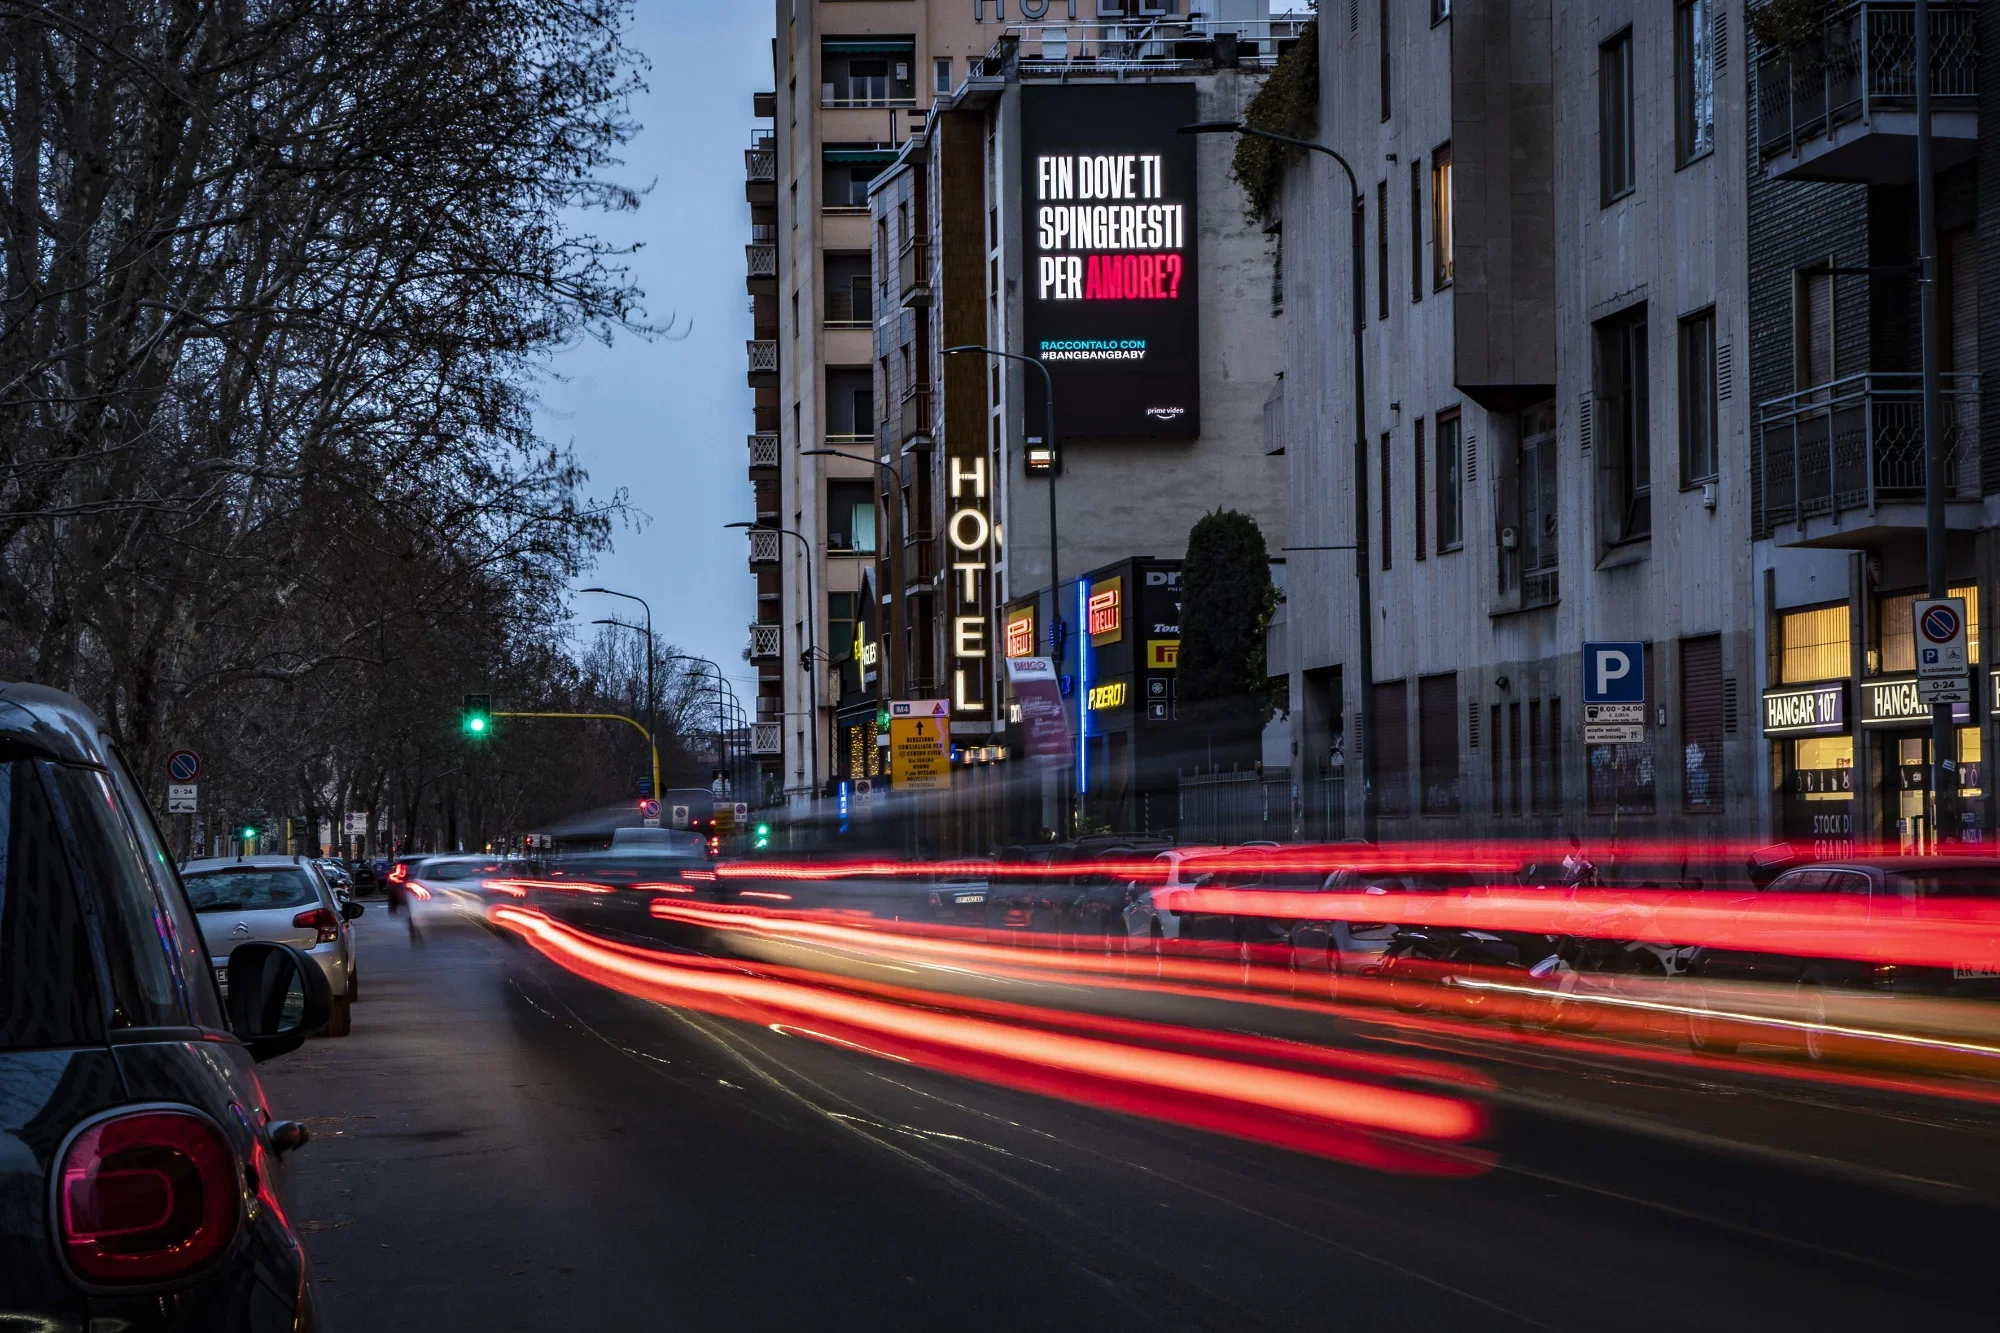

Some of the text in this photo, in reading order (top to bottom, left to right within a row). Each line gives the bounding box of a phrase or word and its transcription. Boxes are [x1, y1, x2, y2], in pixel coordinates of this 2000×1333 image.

[1039, 155, 1161, 200] FIN DOVE TI
[1039, 204, 1183, 249] SPINGERESTI
[1039, 254, 1183, 300] PER AMORE?
[1040, 339, 1146, 350] RACCONTALO CON
[1040, 350, 1146, 360] #BANGBANGBABY
[1147, 406, 1185, 415] prime video
[949, 456, 989, 711] HOTEL
[1925, 650, 1936, 660] P
[1597, 650, 1631, 695] P
[1927, 665, 1964, 673] ciclomotori
[1932, 680, 1956, 690] 0-24
[1768, 692, 1837, 727] HANGAR 107
[1813, 814, 1841, 834] STOCK
[1814, 839, 1853, 860] GRANDI
